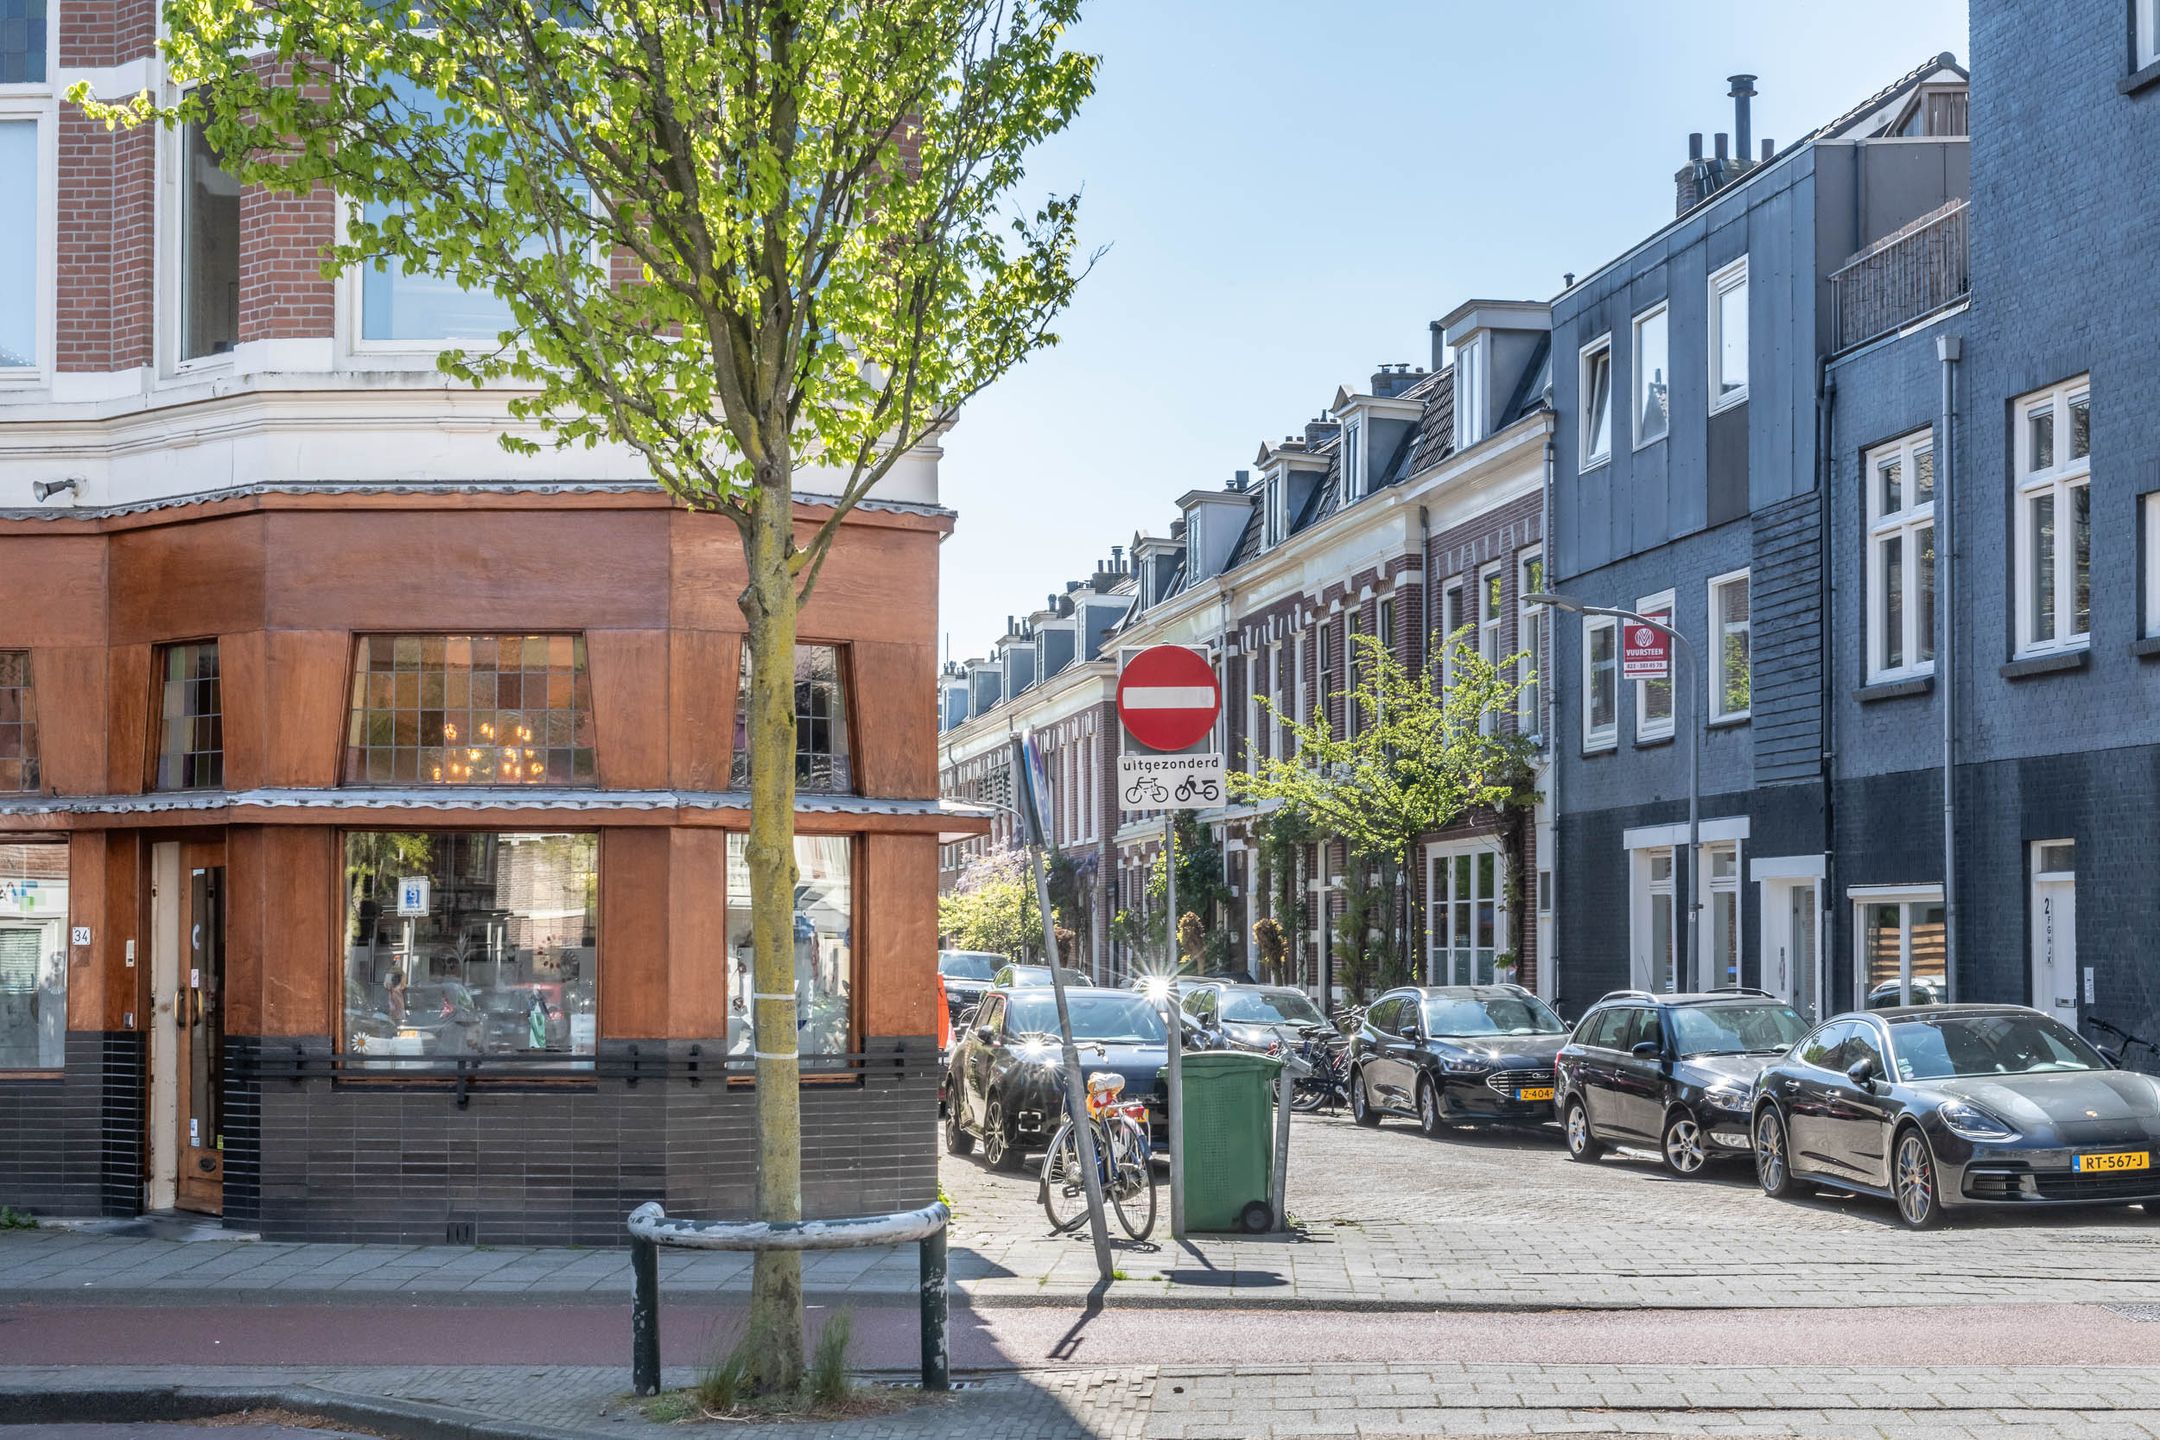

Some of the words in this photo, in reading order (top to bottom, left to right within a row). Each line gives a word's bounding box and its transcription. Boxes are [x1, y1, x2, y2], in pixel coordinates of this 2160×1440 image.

[1626, 648, 1663, 656] VUURSTEEN
[1123, 757, 1219, 773] uitgezonderd
[74, 929, 88, 942] 34
[2086, 1154, 2143, 1169] RT-567-J
